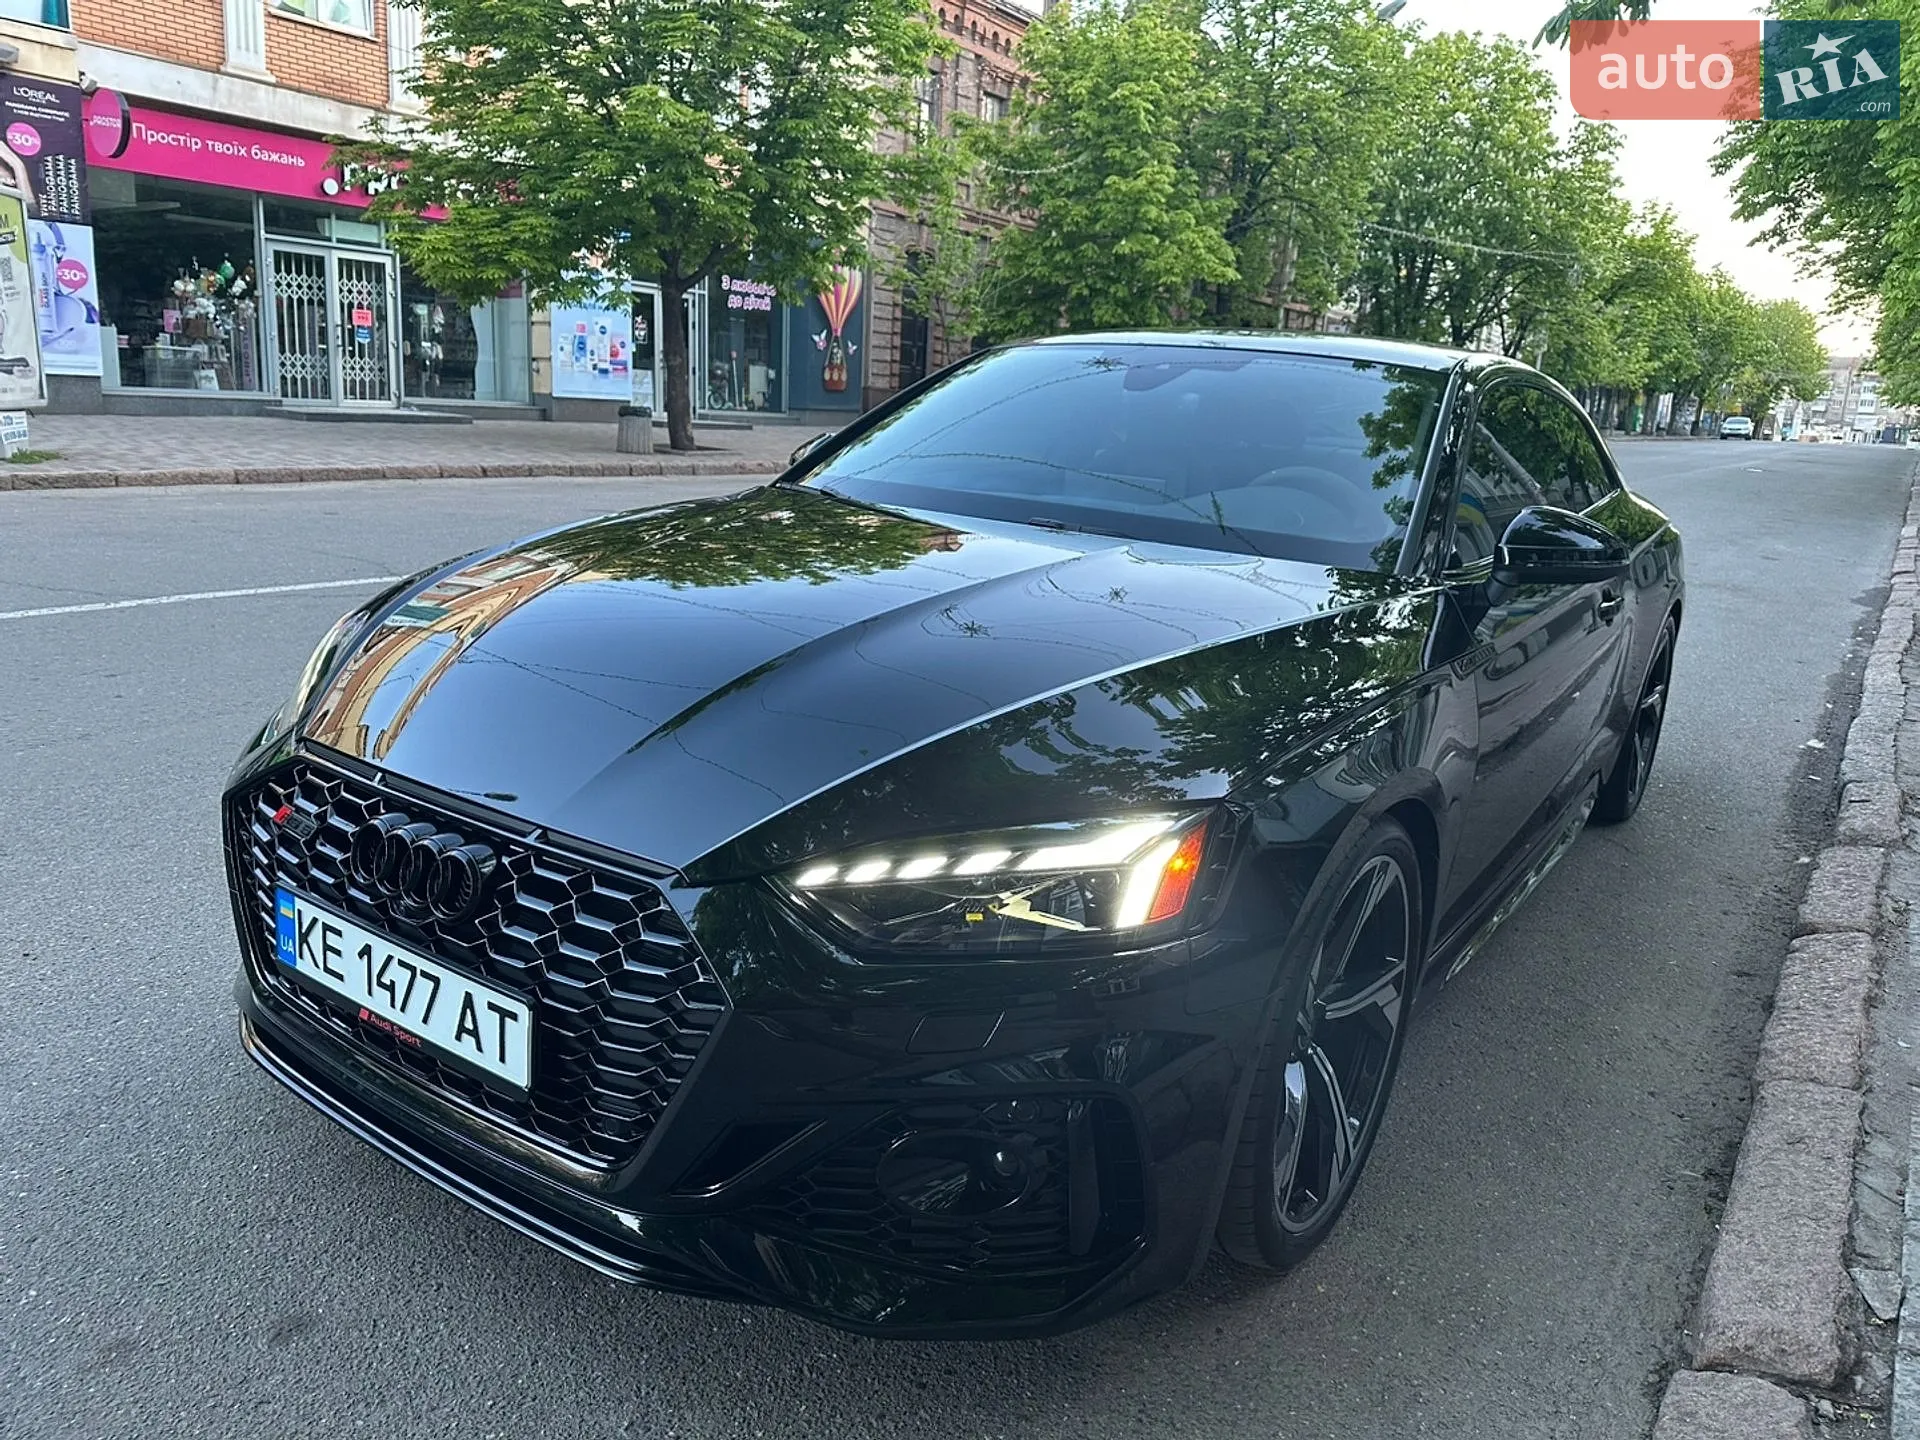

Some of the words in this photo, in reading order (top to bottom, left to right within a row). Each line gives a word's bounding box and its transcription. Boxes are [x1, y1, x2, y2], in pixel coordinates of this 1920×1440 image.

[132, 123, 202, 154] Простір
[205, 138, 248, 158] твоїх
[251, 142, 306, 168] бажань
[727, 294, 743, 309] до
[743, 294, 771, 311] дітей
[281, 935, 295, 955] UA
[297, 908, 345, 982] KE
[357, 942, 441, 1026] 1477
[454, 991, 518, 1064] AT
[370, 1013, 393, 1033] Audi
[392, 1024, 423, 1048] Sport
